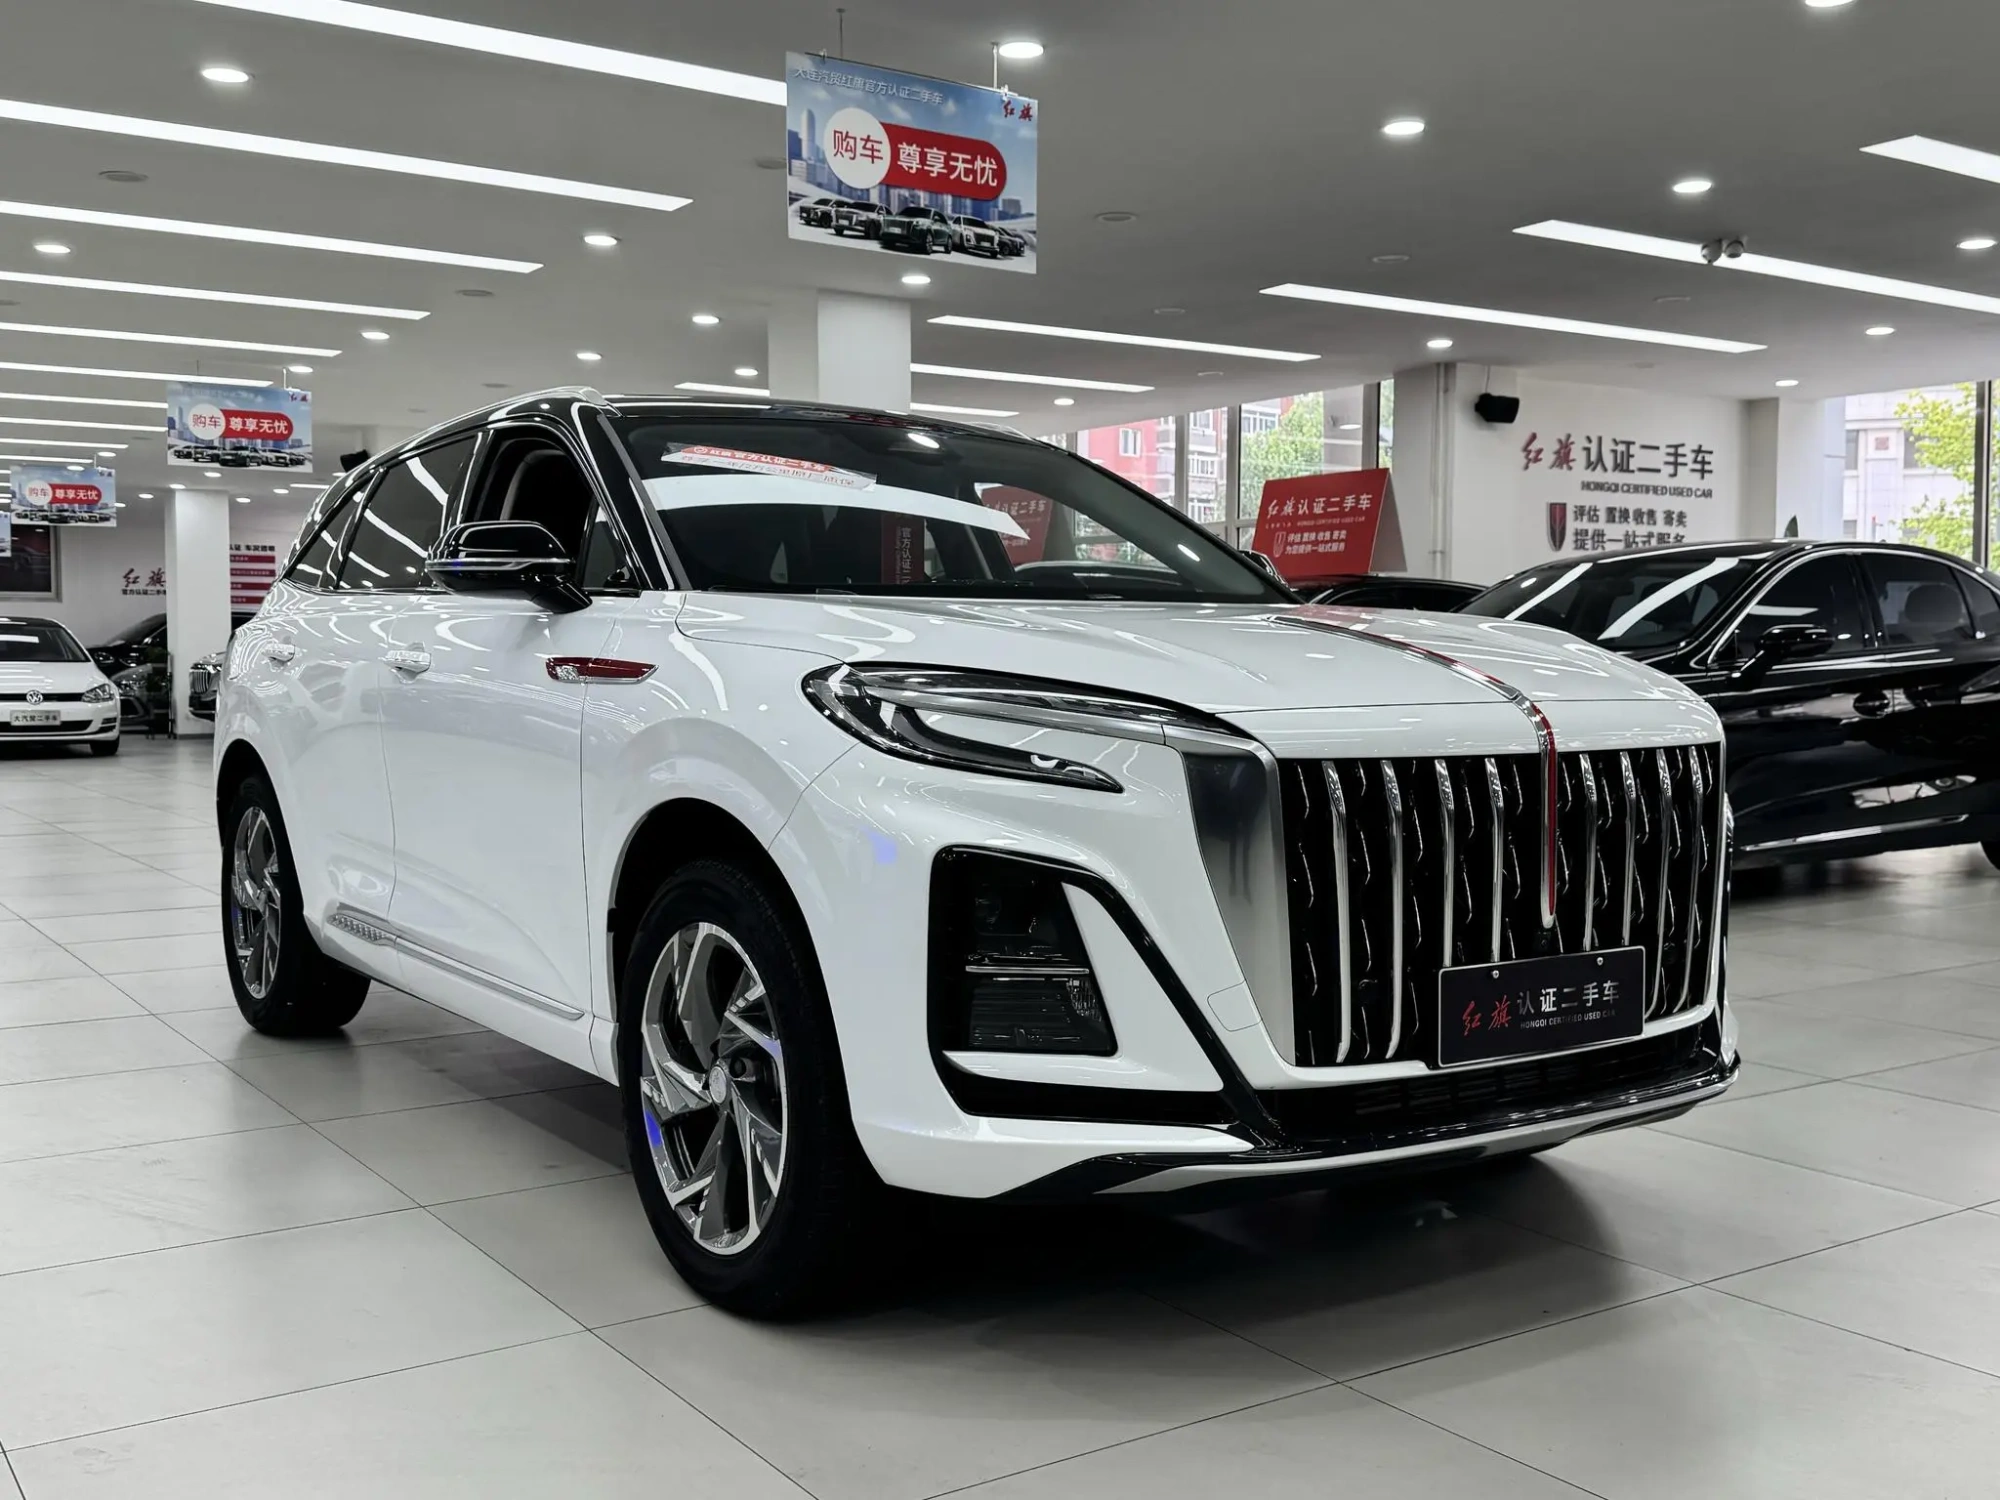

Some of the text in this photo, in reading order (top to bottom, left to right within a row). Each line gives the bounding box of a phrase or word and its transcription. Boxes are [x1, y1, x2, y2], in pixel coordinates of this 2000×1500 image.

[1003, 101, 1033, 121] 红旗
[833, 129, 998, 187] 购车 尊享无忧
[192, 413, 289, 435] 购车 尊享无忧
[55, 489, 99, 500] 尊享无忧
[1581, 480, 1713, 499] HONGQI CERTIFIED USED CAR
[1573, 504, 1600, 524] 评估
[1520, 1019, 1547, 1029] HONGQI
[1549, 1014, 1582, 1026] CERTIFIED
[1584, 1011, 1601, 1021] USED
